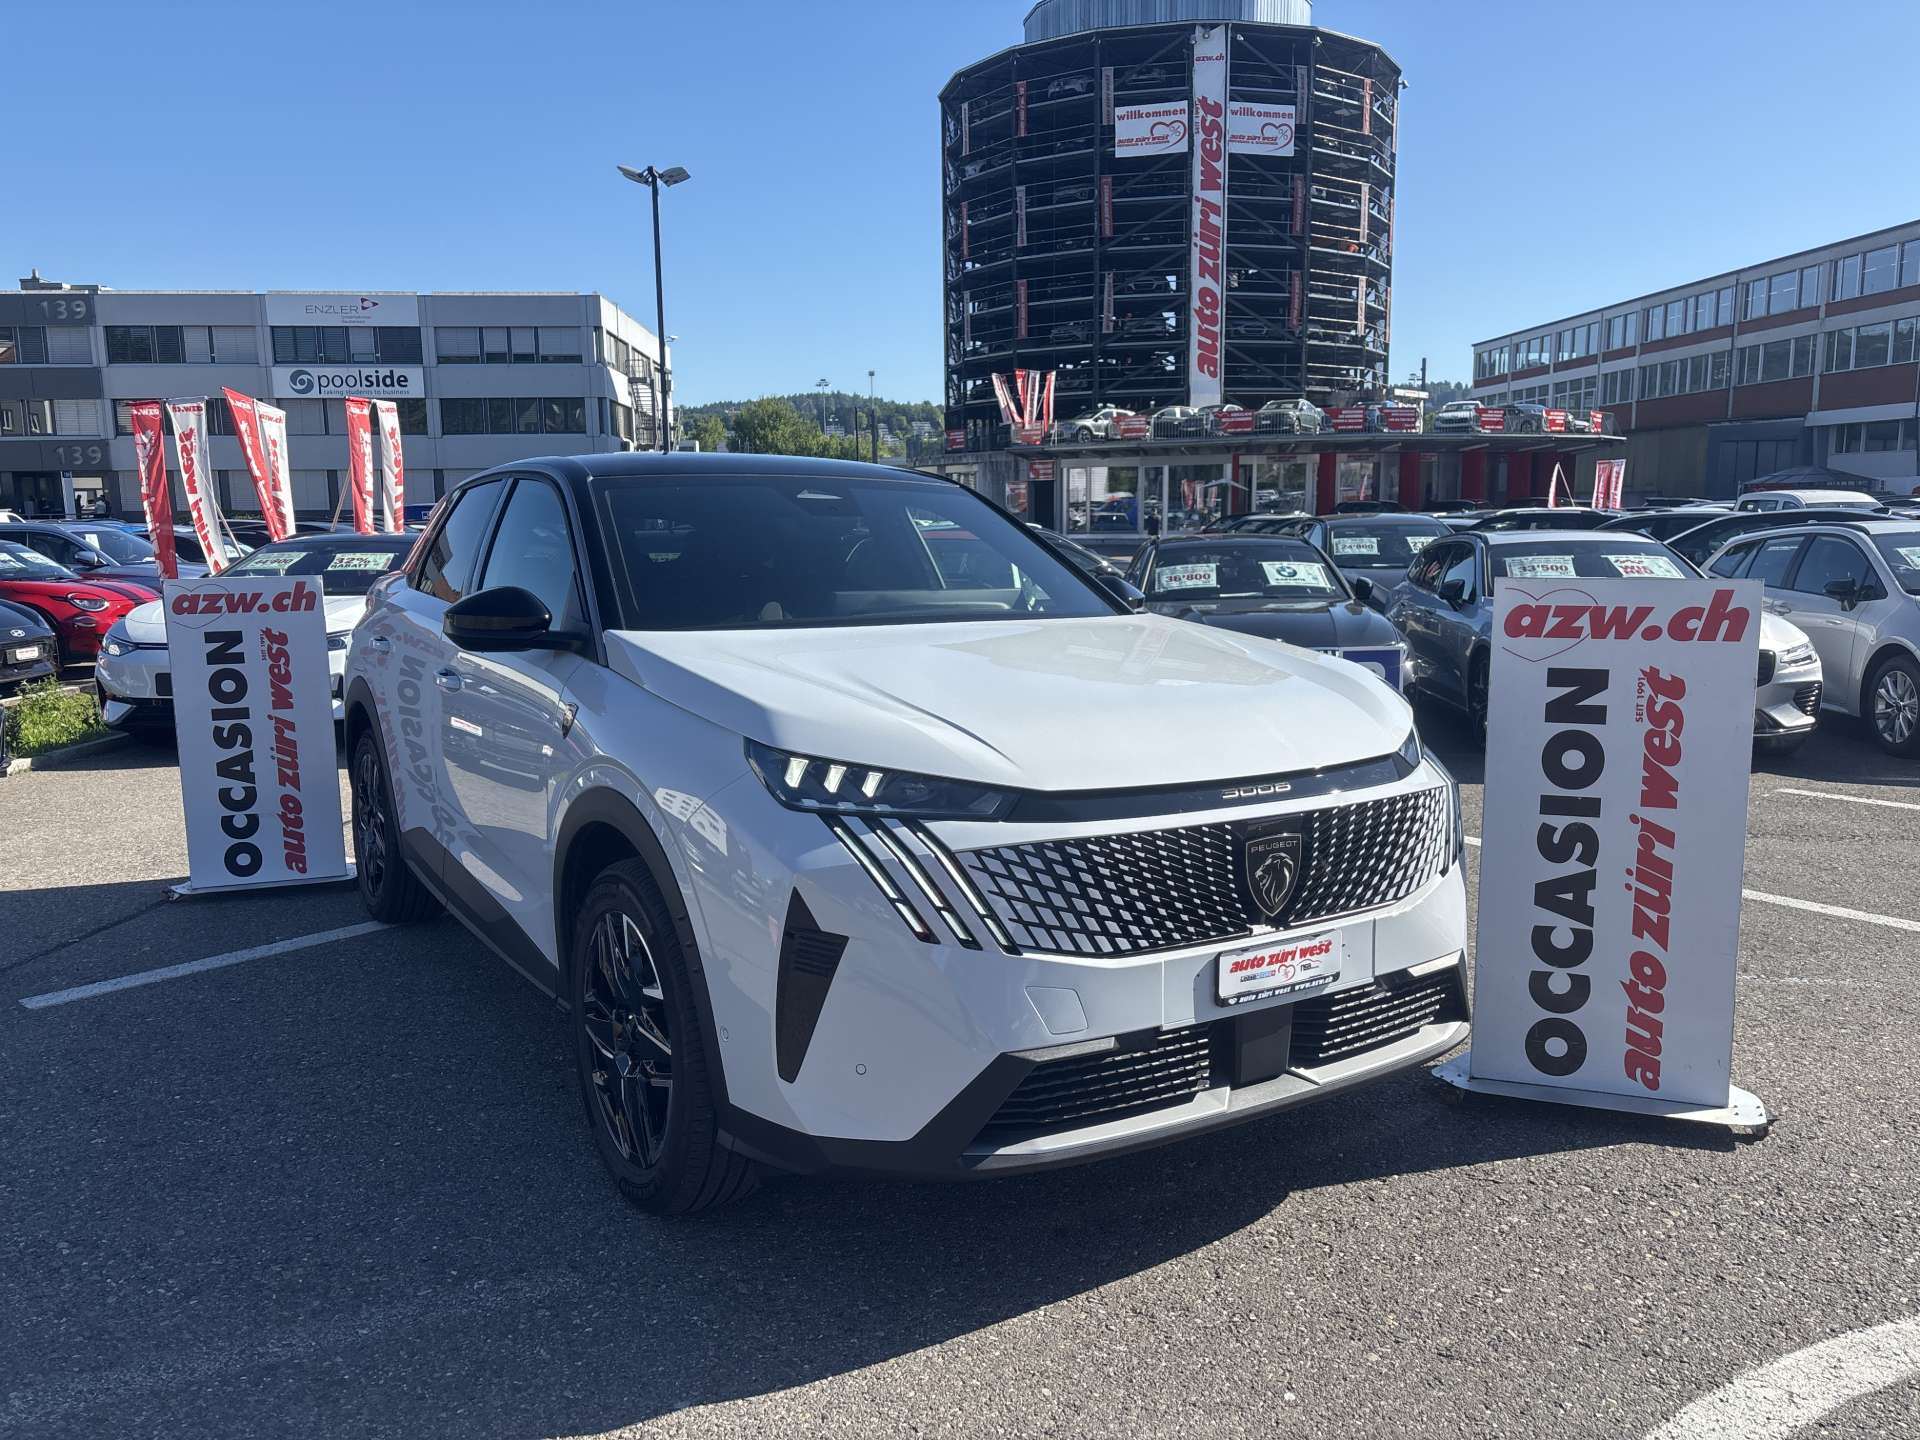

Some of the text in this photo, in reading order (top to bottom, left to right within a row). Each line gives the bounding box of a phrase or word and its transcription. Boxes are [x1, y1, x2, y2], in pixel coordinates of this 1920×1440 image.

[1194, 53, 1225, 62] azw.ch
[1117, 107, 1186, 121] willkommen
[1230, 106, 1294, 119] willkommen
[1193, 96, 1223, 379] auto züri west
[40, 299, 87, 320] 139
[305, 304, 359, 314] ENZLER
[318, 369, 409, 395] poolside
[323, 388, 344, 396] taking
[56, 446, 103, 466] 139
[172, 581, 317, 615] azw.ch
[1504, 589, 1750, 642] azw.ch
[1635, 677, 1646, 723] SEIT 1991
[204, 630, 263, 878] OCCASION
[259, 627, 308, 874] auto züri west
[1250, 840, 1297, 853] PEUGEOT
[1525, 667, 1610, 1076] OCCASION
[1618, 665, 1686, 1091] auto züri west
[1229, 940, 1333, 974] auto züri west
